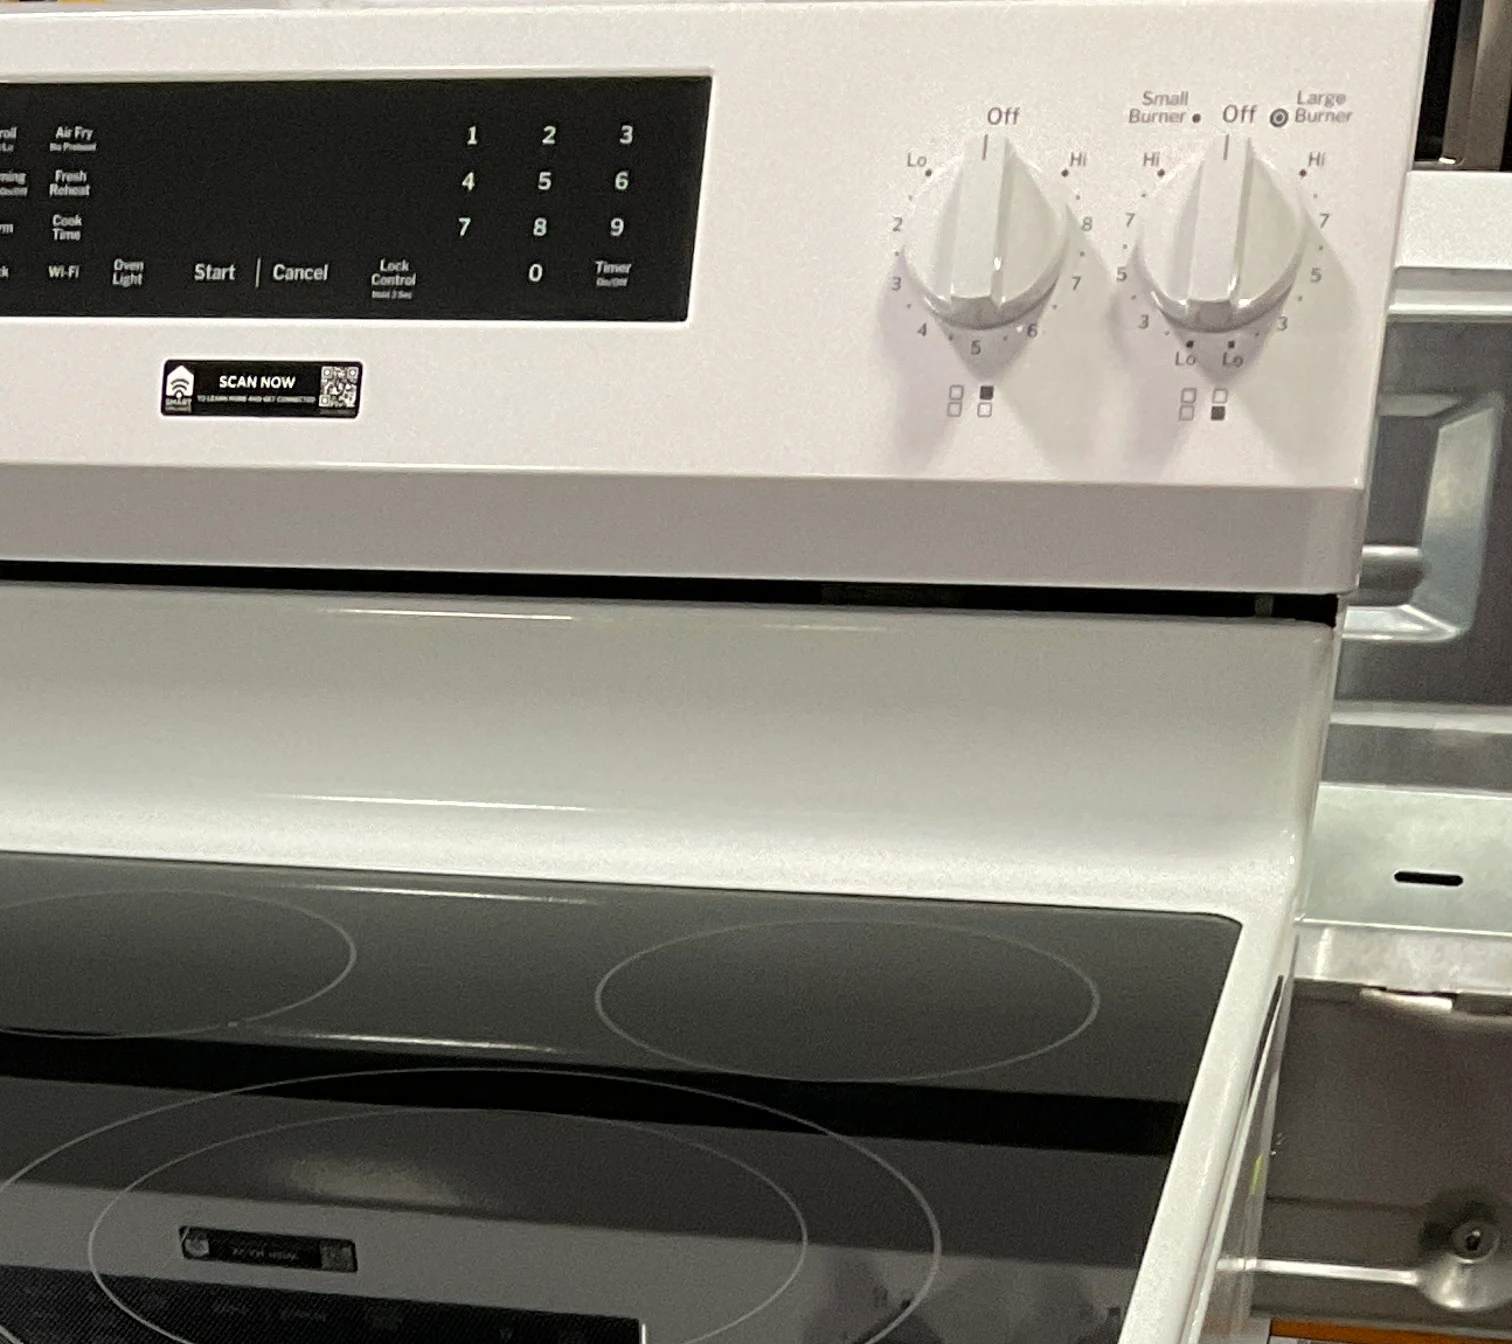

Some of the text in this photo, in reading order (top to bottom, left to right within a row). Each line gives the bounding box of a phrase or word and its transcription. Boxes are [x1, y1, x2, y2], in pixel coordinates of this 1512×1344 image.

[1142, 91, 1189, 106] Small
[1296, 90, 1347, 108] Large
[987, 107, 1021, 125] Off
[1128, 109, 1186, 124] Burner
[1222, 105, 1258, 124] Off
[1295, 107, 1353, 123] Burner
[55, 126, 94, 142] Air Fry
[467, 126, 478, 145] 1
[541, 126, 556, 145] 2
[620, 125, 634, 144] 3
[906, 152, 928, 168] Lo
[1070, 152, 1087, 168] Hi
[1142, 152, 1159, 168] Hi
[1308, 152, 1325, 168] Hi
[55, 170, 87, 183] Fresh
[461, 172, 476, 191] 4
[537, 171, 552, 190] 5
[614, 171, 629, 190] 6
[49, 184, 91, 197] Reheat
[52, 214, 83, 227] Cook
[458, 218, 472, 236] 7
[532, 218, 547, 237] 8
[609, 217, 624, 236] 9
[892, 216, 903, 233] 2
[1081, 216, 1093, 232] 8
[1125, 213, 1136, 228] 7
[1319, 213, 1330, 229] 7
[52, 228, 81, 241] Time
[48, 265, 80, 278] Wi-Fi
[113, 259, 145, 272] Oven
[194, 263, 236, 281] Start
[272, 263, 329, 281] Cancel
[379, 258, 410, 272] Lock
[528, 264, 543, 282] 0
[595, 260, 632, 275] Timer
[112, 271, 144, 287] Light
[371, 273, 417, 286] Control
[1116, 267, 1127, 282] 5
[1310, 267, 1322, 283] 5
[891, 276, 902, 292] 3
[1071, 276, 1082, 292] 7
[1138, 314, 1150, 329] 3
[1276, 316, 1288, 331] 3
[916, 323, 928, 339] 4
[1026, 323, 1038, 339] 6
[969, 340, 981, 356] 5
[1175, 351, 1196, 367] Lo
[1222, 352, 1243, 368] Lo
[219, 375, 297, 389] SCAN NOW
